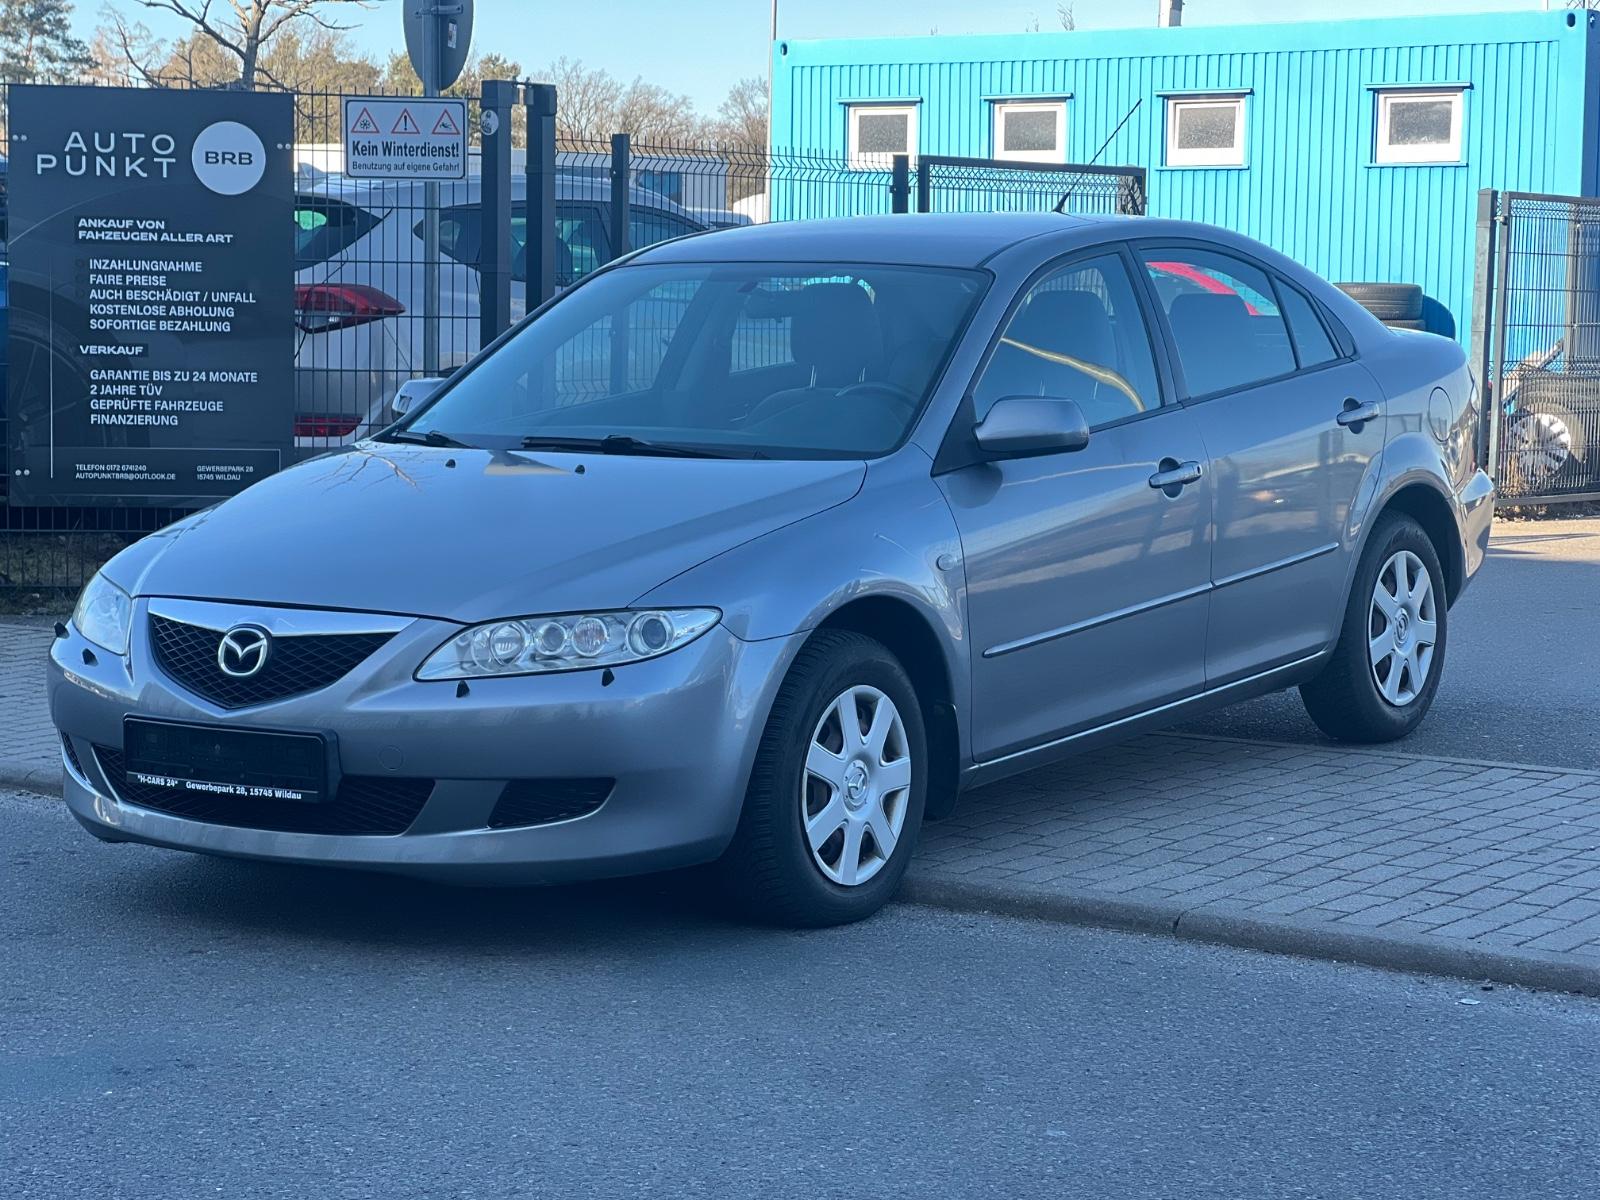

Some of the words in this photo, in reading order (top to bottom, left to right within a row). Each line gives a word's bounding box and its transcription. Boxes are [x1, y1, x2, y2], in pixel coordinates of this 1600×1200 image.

[64, 131, 176, 155] AUTO
[352, 140, 378, 157] Kein
[381, 141, 459, 158] Winterdienst!
[204, 151, 253, 166] BRB
[36, 154, 176, 178] PUNKT
[352, 161, 391, 172] Benutzung
[394, 162, 405, 171] auf
[406, 163, 430, 173] eigene
[432, 162, 459, 172] Gefahr!
[78, 218, 133, 229] ANKAUF
[136, 219, 165, 230] VON
[78, 230, 157, 242] FAHZEUGEN
[160, 232, 203, 243] ALLER
[206, 234, 233, 243] ART
[90, 259, 202, 272] INZAHLUNGNAHME
[90, 274, 123, 285] FAIRE
[126, 275, 166, 287] PREISE
[90, 289, 122, 300] AUCH
[126, 288, 201, 302] BESCHÄDIGT
[203, 291, 208, 302] /
[211, 292, 256, 303] UNFALL
[90, 304, 166, 316] KOSTENLOSE
[169, 306, 235, 318] ABHOLUNG
[90, 319, 156, 331] SOFORTIGE
[159, 320, 231, 333] BEZAHLUNG
[79, 345, 143, 355] VERKAUF
[90, 370, 149, 381] GARANTIE
[153, 370, 171, 381] BIS
[174, 371, 189, 382] ZU
[192, 371, 206, 382] 24
[209, 372, 258, 383] MONATE
[90, 384, 97, 395] 2
[100, 384, 136, 395] JAHRE
[139, 383, 163, 396] TÜV
[90, 398, 152, 411] GEPRÜFTE
[154, 400, 224, 412] FAHRZEUGE
[90, 414, 178, 426] FINANZIERUNG
[215, 473, 241, 481] WILDAU
[186, 781, 234, 794] Gewerbepark
[236, 786, 248, 796] 28,
[249, 788, 273, 797] 15745
[274, 789, 302, 799] Wildau
